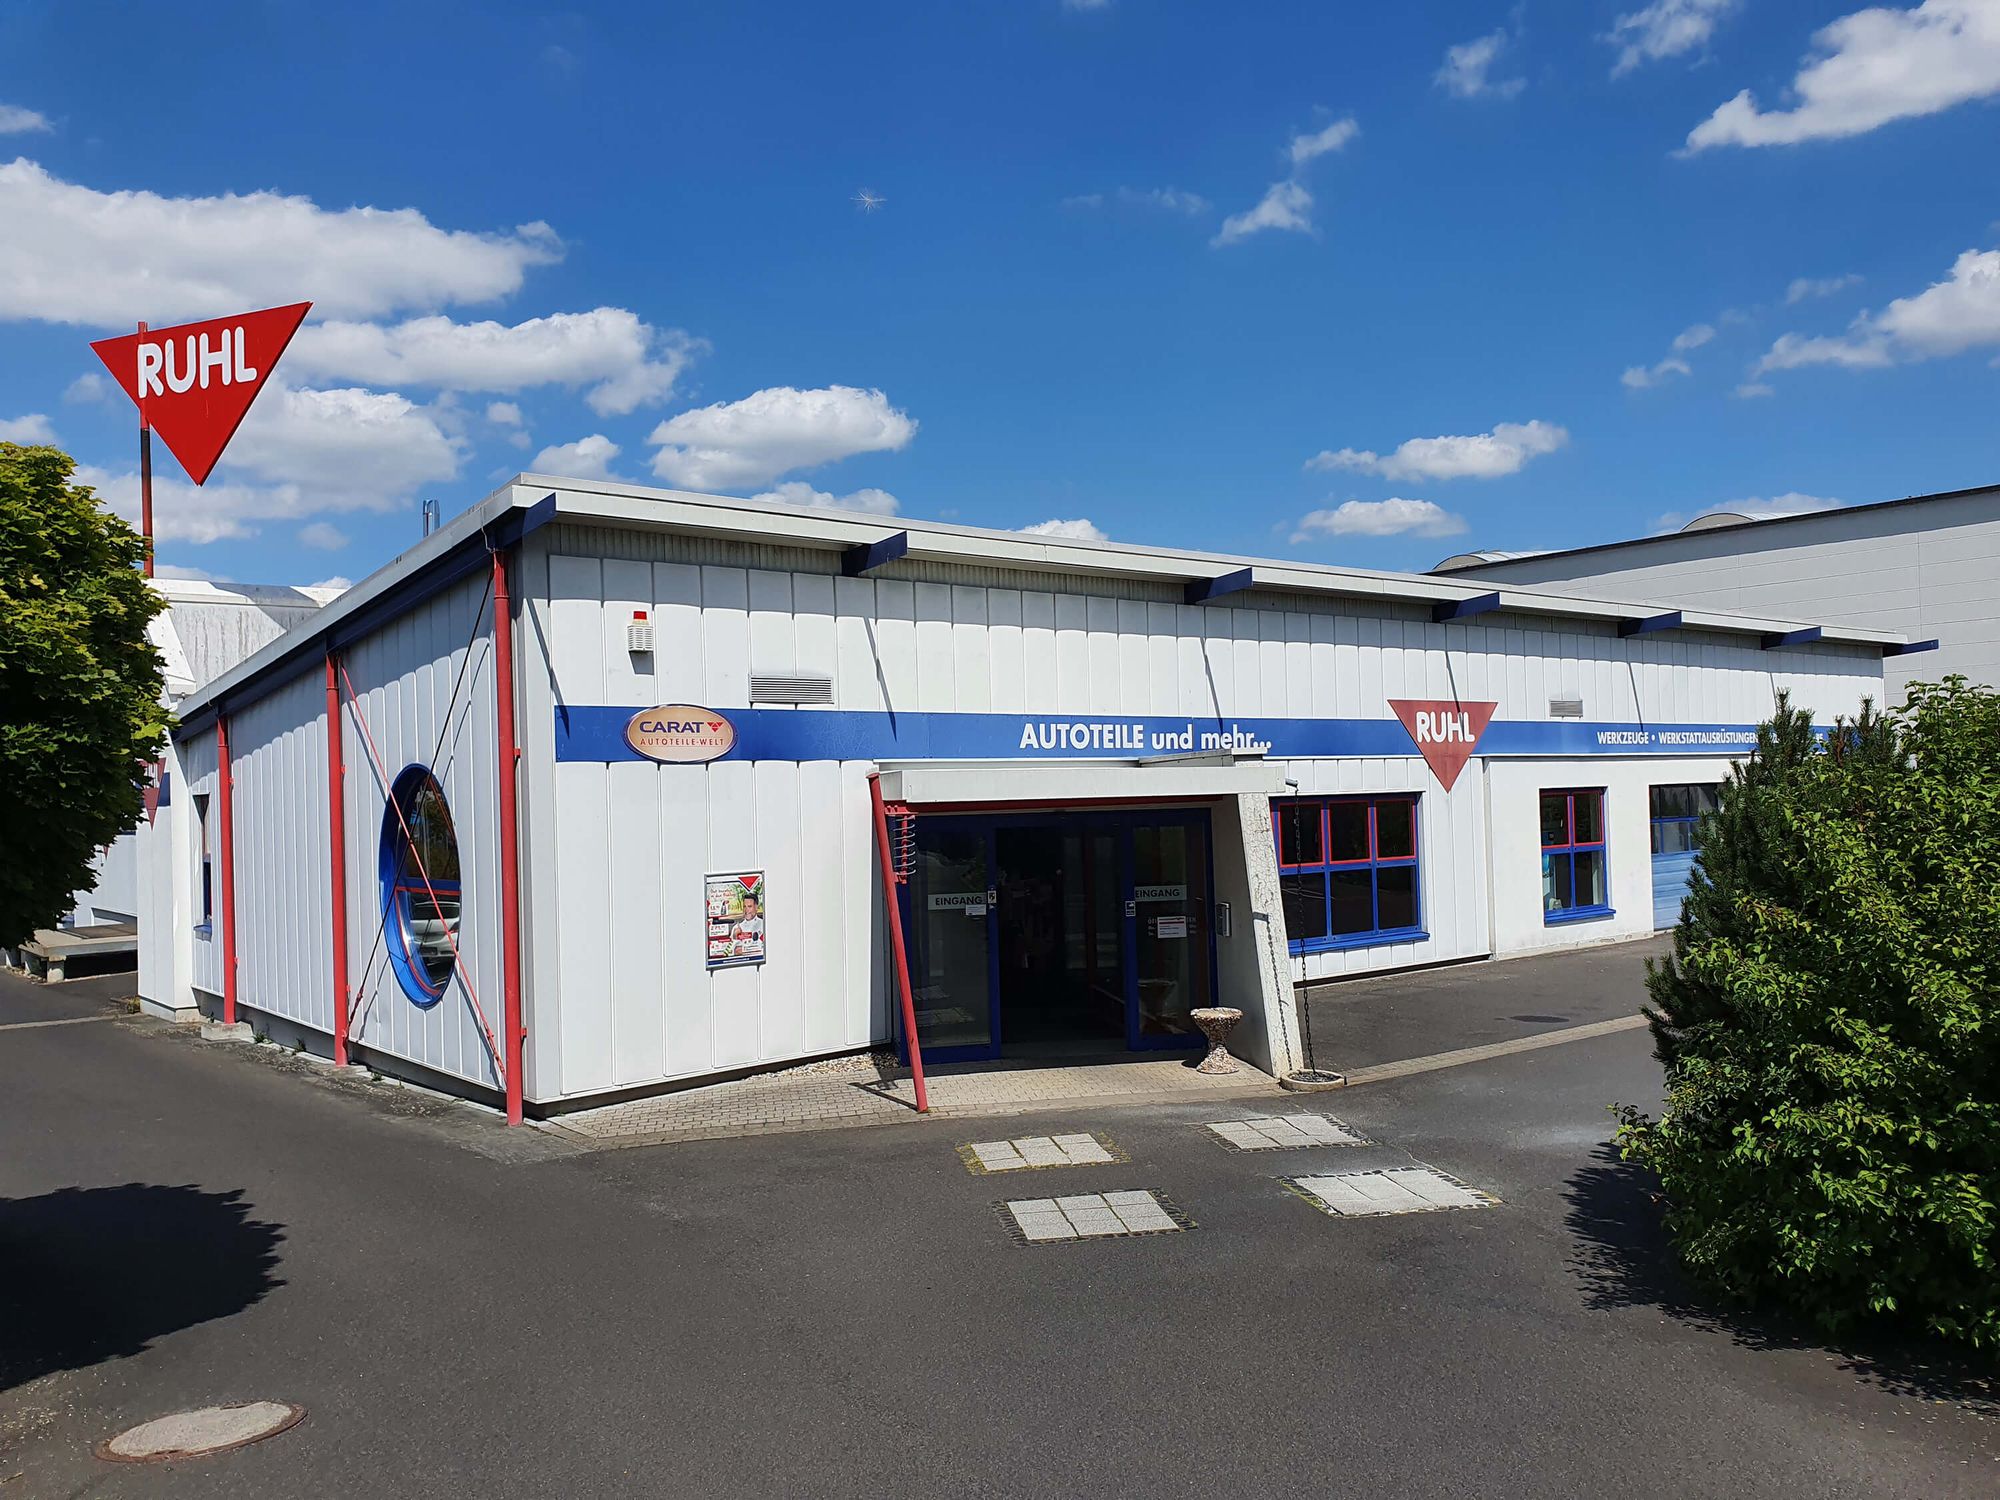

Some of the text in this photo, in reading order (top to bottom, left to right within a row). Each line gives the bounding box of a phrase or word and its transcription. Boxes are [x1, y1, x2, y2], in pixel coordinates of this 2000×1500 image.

[138, 326, 258, 399] RUHL
[639, 721, 704, 733] CARAT
[1416, 711, 1475, 743] RUHL
[640, 738, 724, 746] AUTOTEILE-WELT
[1019, 723, 1272, 750] AUTOTEILE und mehr...
[1597, 731, 1649, 745] WERKZEUGE
[1135, 888, 1180, 899] EINGANG
[935, 896, 982, 906] EINGANG
